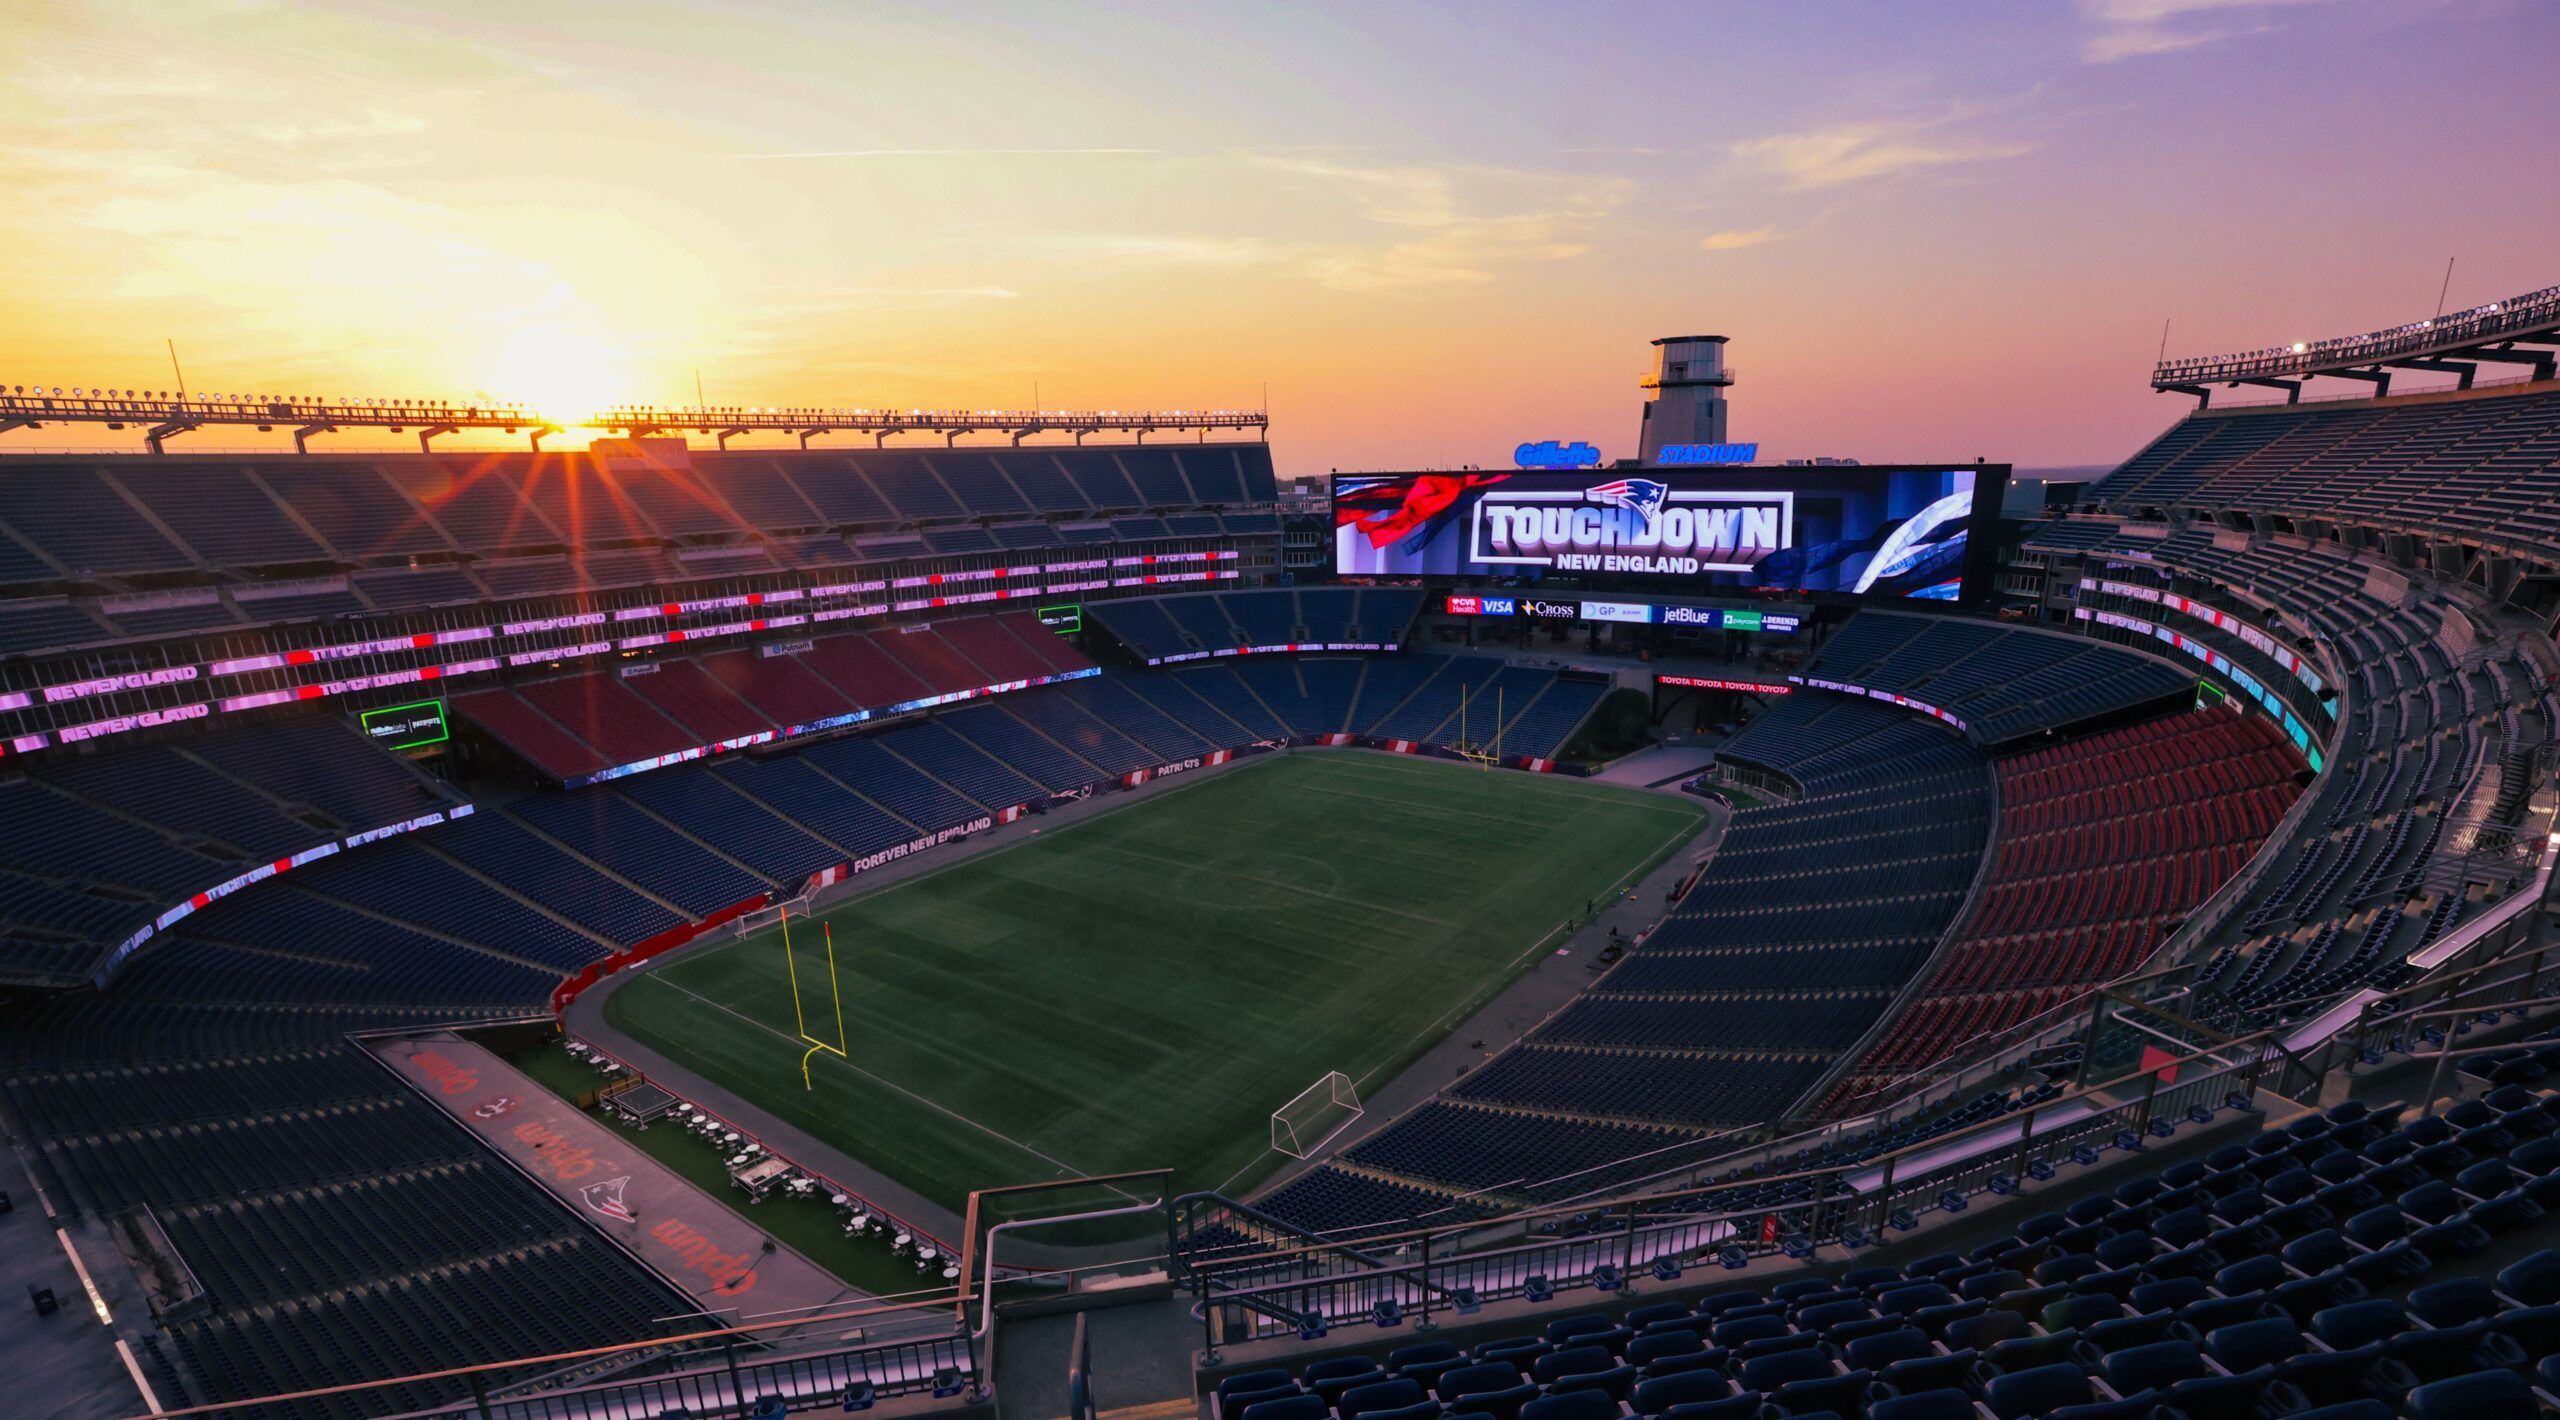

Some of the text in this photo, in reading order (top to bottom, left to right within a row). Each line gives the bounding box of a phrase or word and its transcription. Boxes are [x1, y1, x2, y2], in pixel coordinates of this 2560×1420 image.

[1514, 440, 1600, 466] Gillette
[1657, 443, 1758, 464] STADIUM
[1486, 505, 1779, 550] TOUCHDOWN
[1557, 553, 1699, 575] NEW ENGLAND
[1482, 600, 1513, 613] VISA
[1663, 607, 1709, 624] jetBlue
[1733, 618, 1760, 626] paycom
[781, 642, 809, 652] Putnam
[1661, 676, 1788, 694] TOYOTA TOYOTA TOYOTA TOYOTA
[854, 843, 908, 873] FOREVER
[909, 834, 936, 853] NEW
[650, 1218, 757, 1297] Optum
